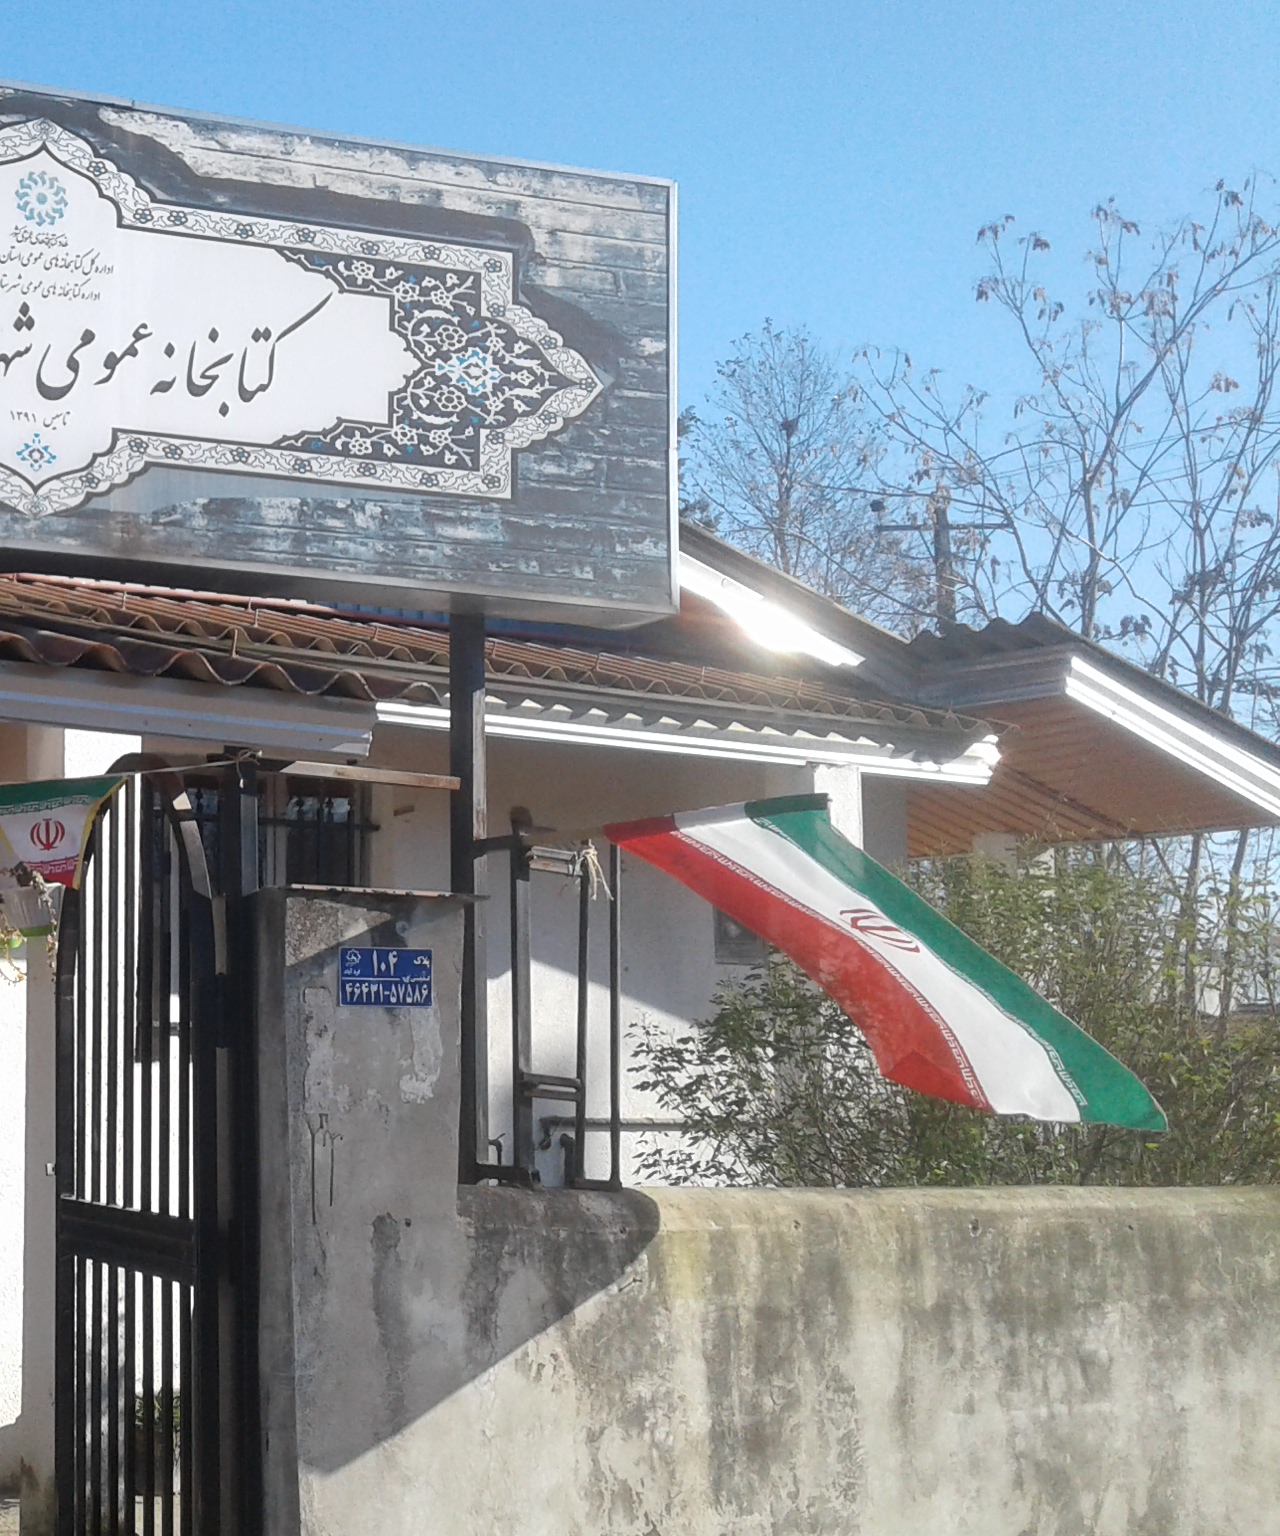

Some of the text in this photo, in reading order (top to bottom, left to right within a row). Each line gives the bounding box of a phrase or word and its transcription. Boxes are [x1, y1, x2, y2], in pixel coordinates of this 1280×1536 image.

[20, 251, 44, 267] عمومی
[82, 252, 101, 276] کل
[95, 265, 114, 275] اداره
[21, 280, 44, 295] عمومی
[81, 291, 101, 301] اداره
[35, 322, 153, 401] عمومی
[149, 291, 333, 417] کتابخانه
[372, 950, 430, 976] پلاک ۱۰۴
[345, 982, 429, 1004] ۴۶۴۳۱-۵۷۵۸۶
